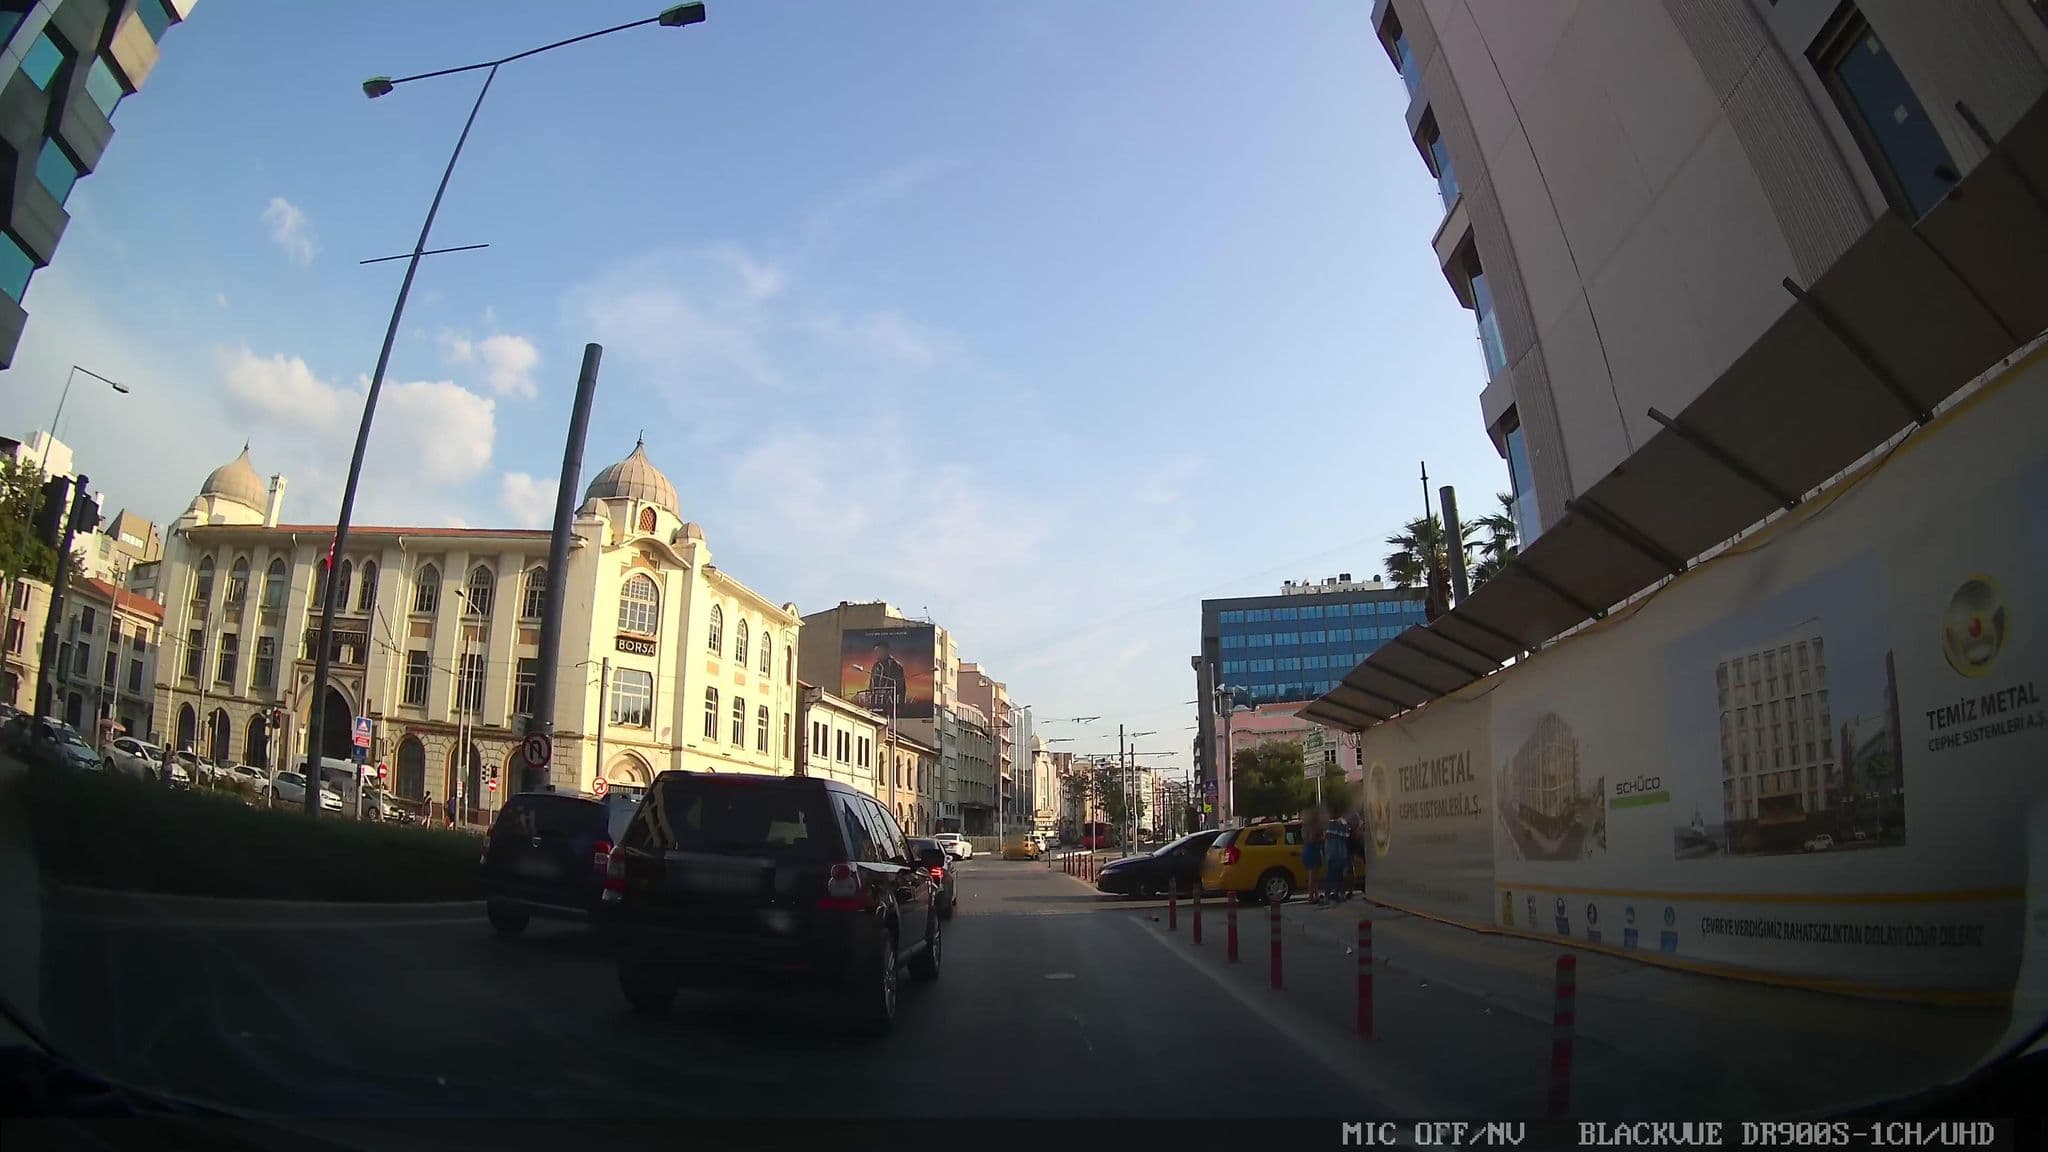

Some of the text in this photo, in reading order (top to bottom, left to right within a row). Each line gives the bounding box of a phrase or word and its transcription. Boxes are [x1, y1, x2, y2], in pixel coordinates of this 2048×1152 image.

[618, 639, 655, 656] BORSA
[1926, 681, 2041, 731] TEMİZ METAL
[1927, 732, 1961, 752] CEPHE
[1398, 750, 1475, 792] TEMİZ METAL
[1616, 775, 1662, 795] SCHÜCO
